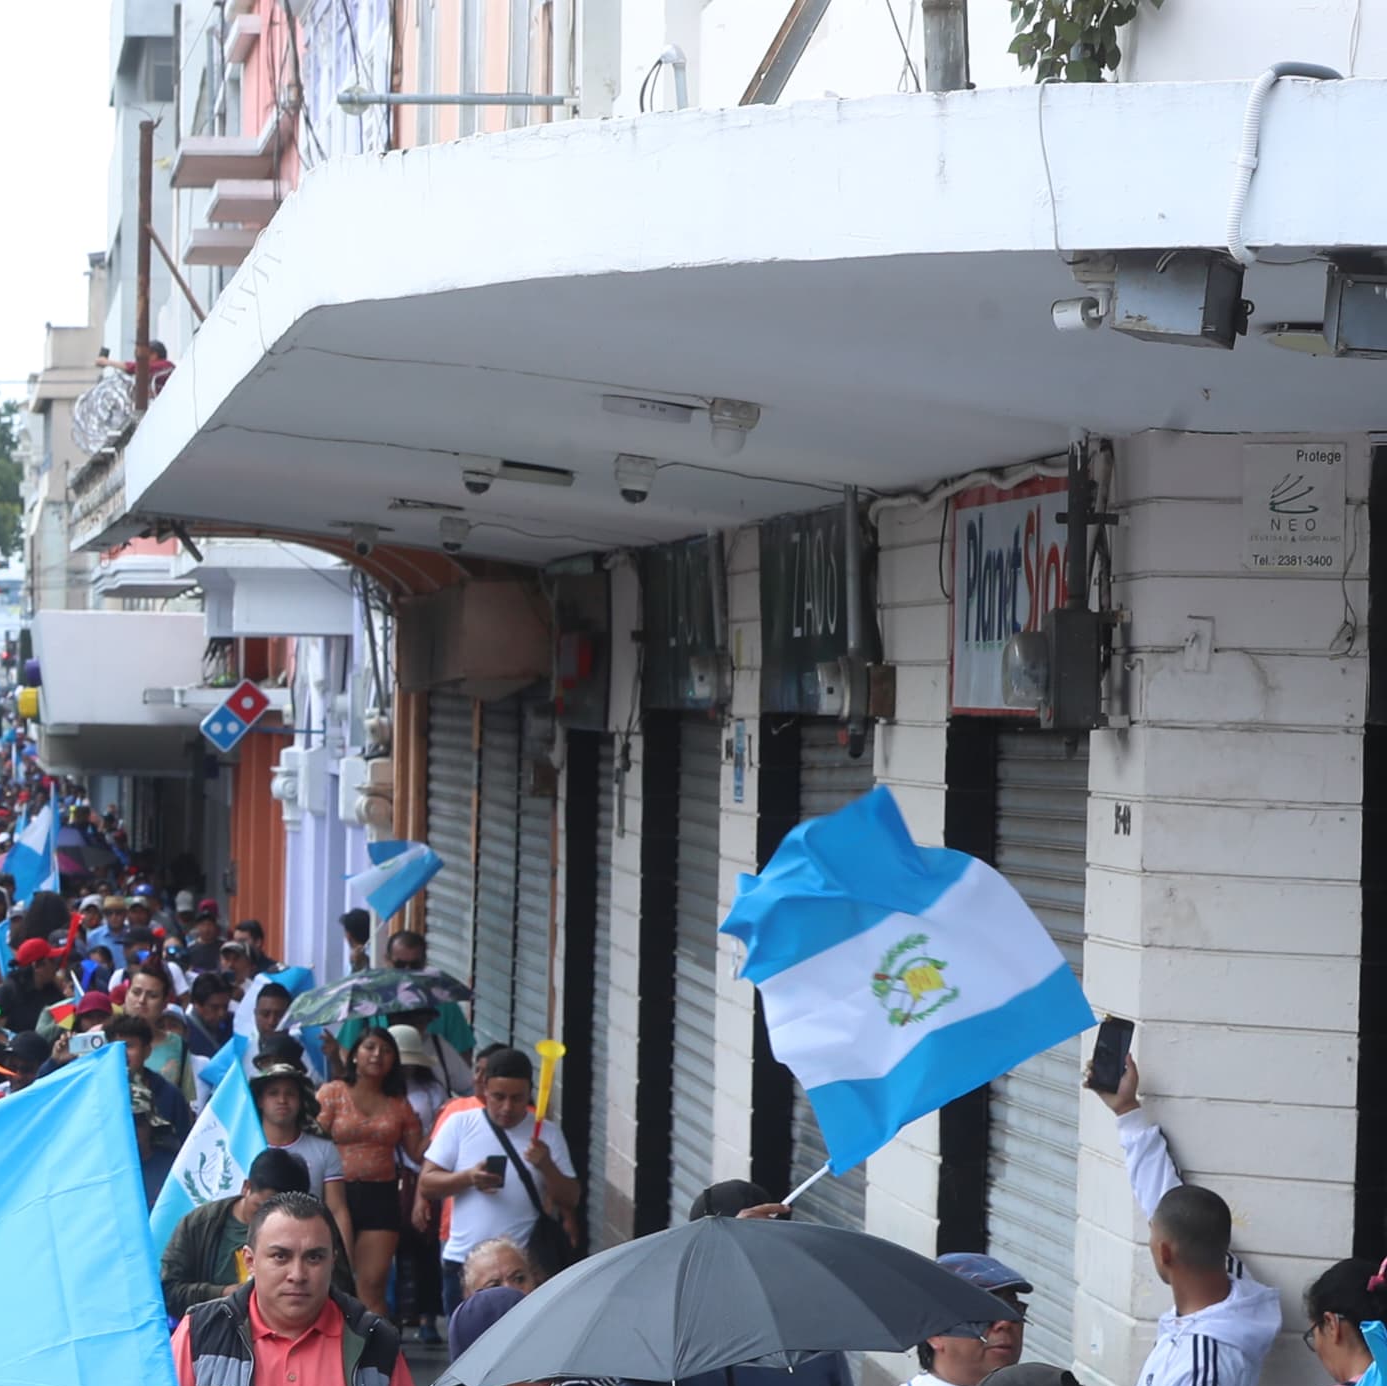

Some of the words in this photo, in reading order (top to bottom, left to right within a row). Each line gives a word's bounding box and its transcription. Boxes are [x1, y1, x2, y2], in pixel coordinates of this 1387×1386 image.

[1296, 449, 1341, 464] Protege
[1271, 518, 1316, 531] NEO
[1277, 555, 1333, 566] 2381-3400
[965, 512, 1022, 642] Planet
[1023, 504, 1069, 632] Sho
